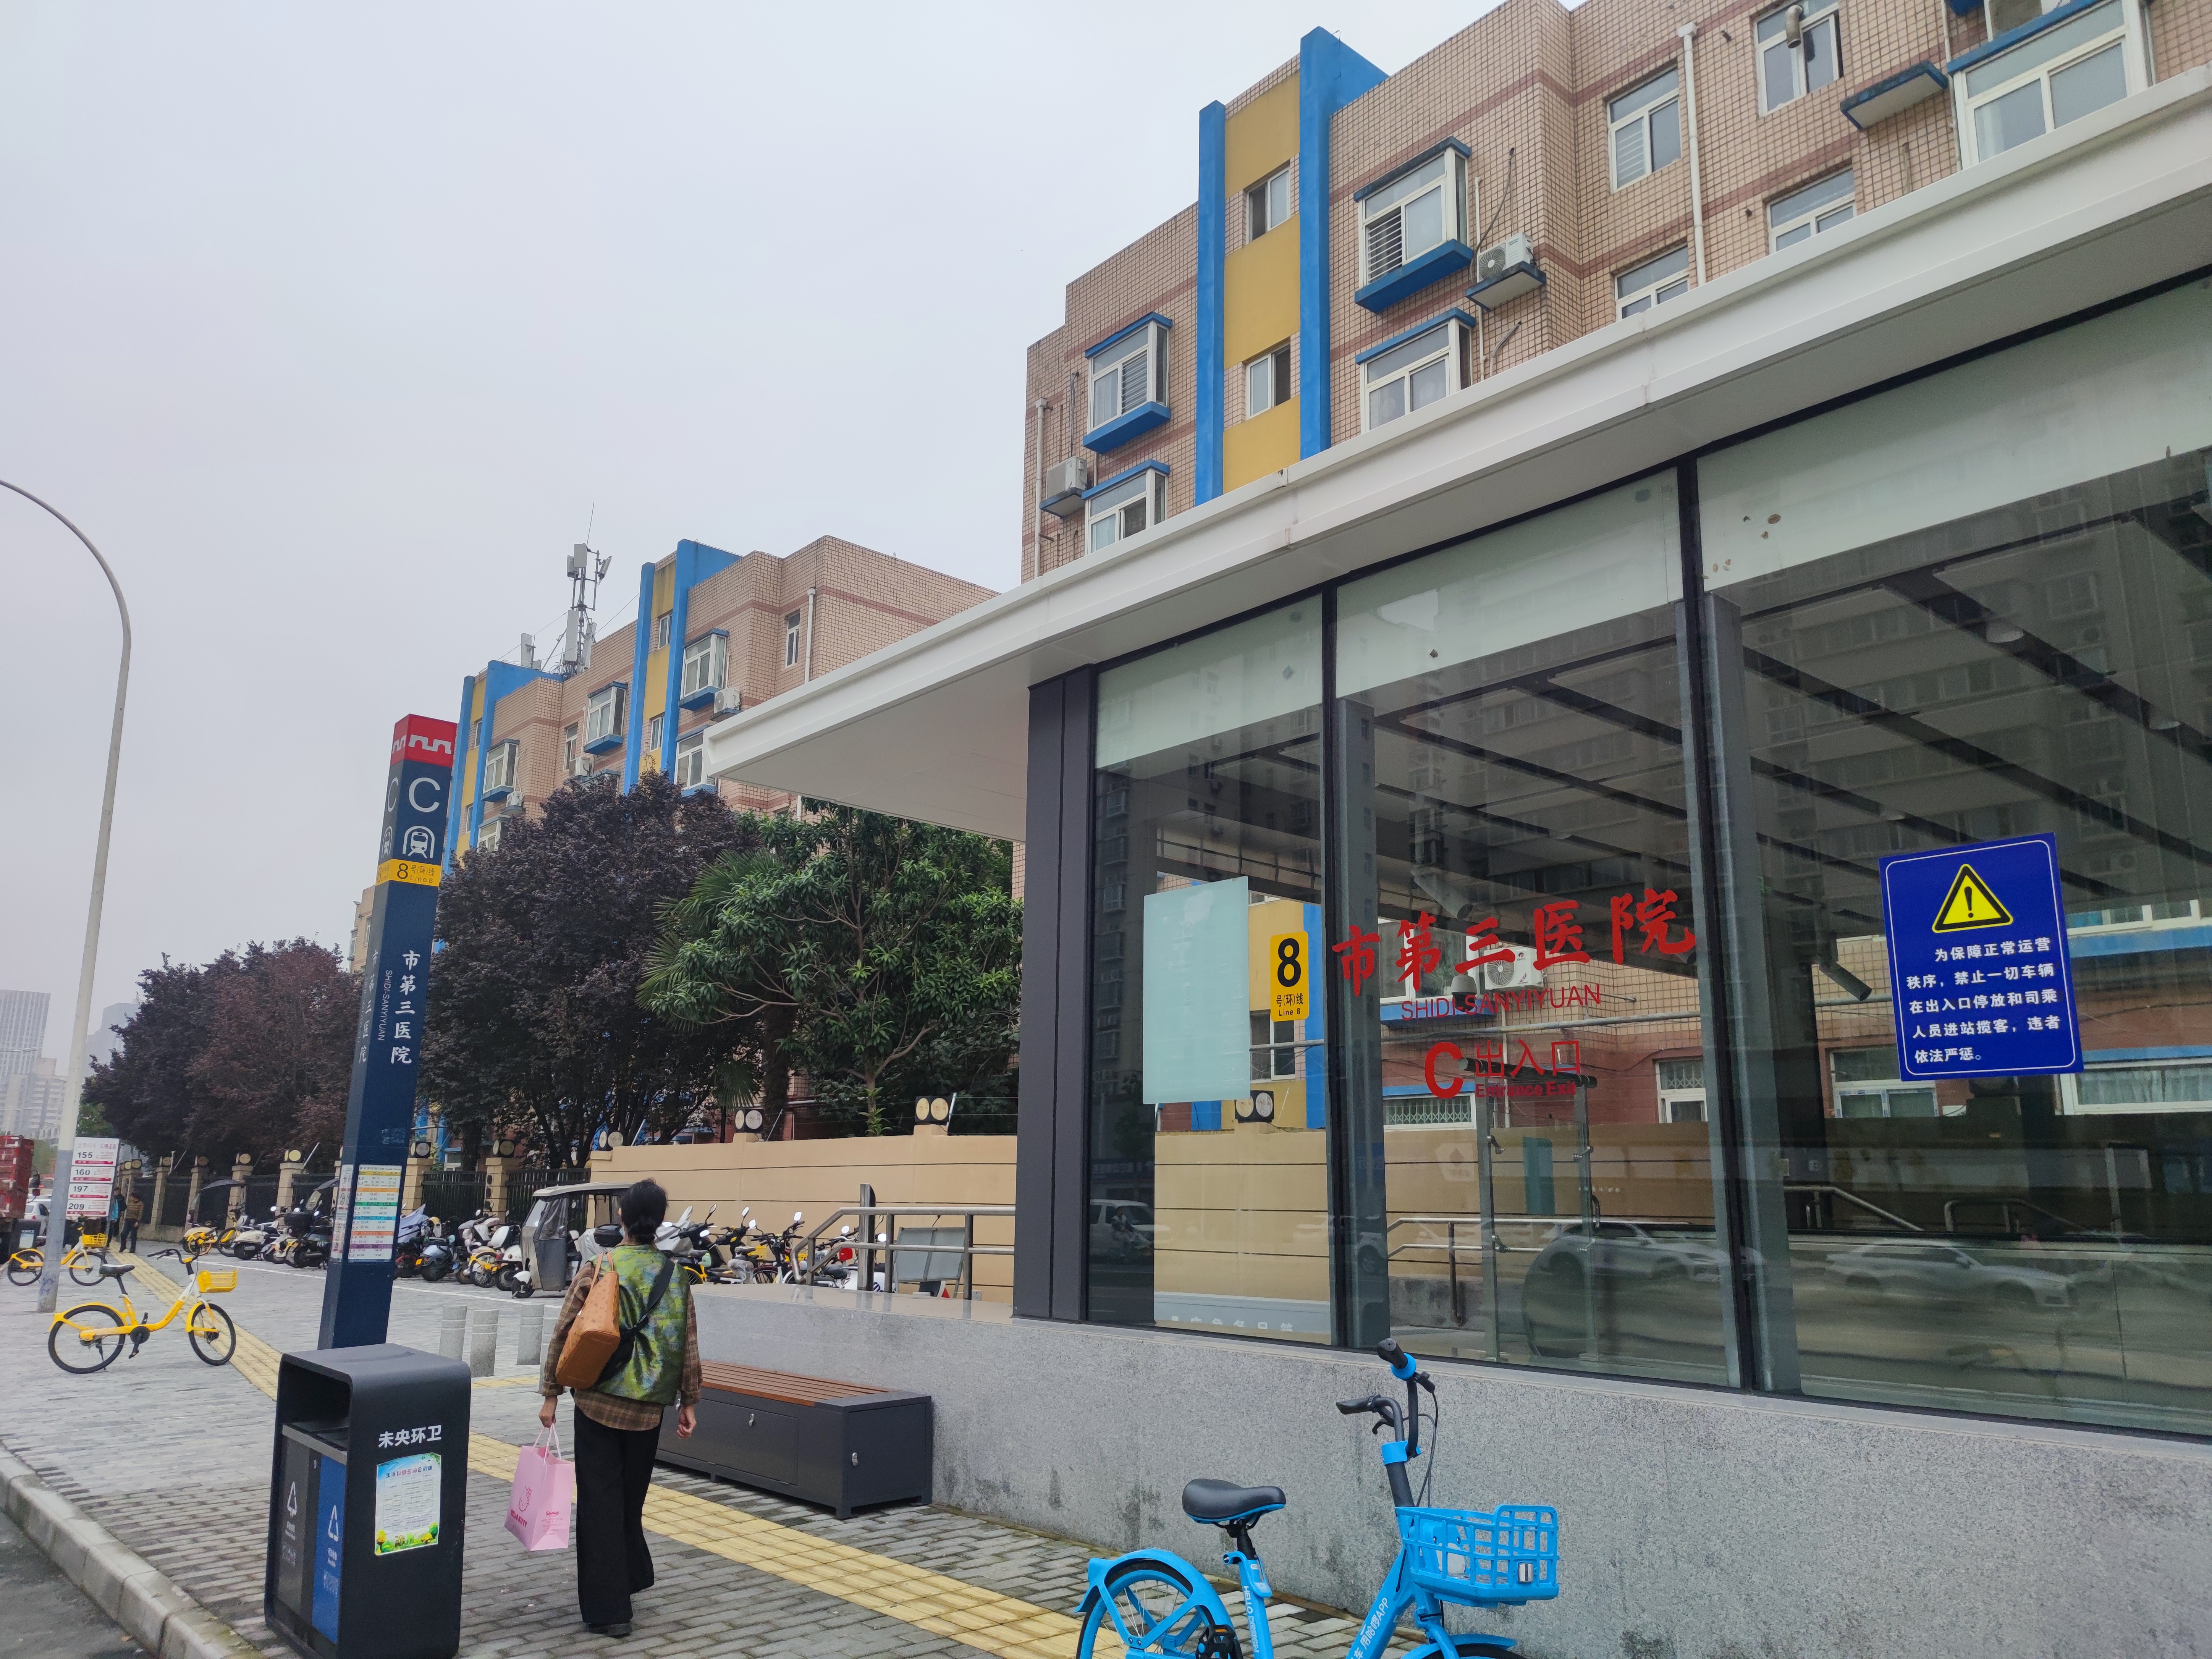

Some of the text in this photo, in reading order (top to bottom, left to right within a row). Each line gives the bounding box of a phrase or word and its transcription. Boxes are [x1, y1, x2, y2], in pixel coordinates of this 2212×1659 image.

[387, 777, 398, 812] C
[408, 777, 441, 812] C
[397, 863, 408, 879] 8
[410, 864, 435, 877] 号(环)线
[1332, 888, 1696, 998] 市第三医院
[1935, 937, 2051, 962] 为保障正常运营
[1277, 938, 1302, 987] 8
[1906, 963, 2055, 990] 秩序，禁止一切车辆
[377, 970, 393, 1041] SHIDI-SANYIYUAN
[391, 949, 421, 1064] 市第三医院
[1276, 993, 1304, 1007] 号(环)线
[1401, 983, 1600, 1020] SHIDI-SANYIYUAN
[1909, 988, 2058, 1014] 在出入口停放和司乘
[1425, 1038, 1581, 1099] C 出入口
[1914, 1047, 1981, 1064] 依法严惩。
[1476, 1080, 1577, 1098] Entrance Exit
[378, 1425, 442, 1448] 未央环卫
[518, 1516, 527, 1527] KITTY
[1243, 1585, 1253, 1614] HELLO
